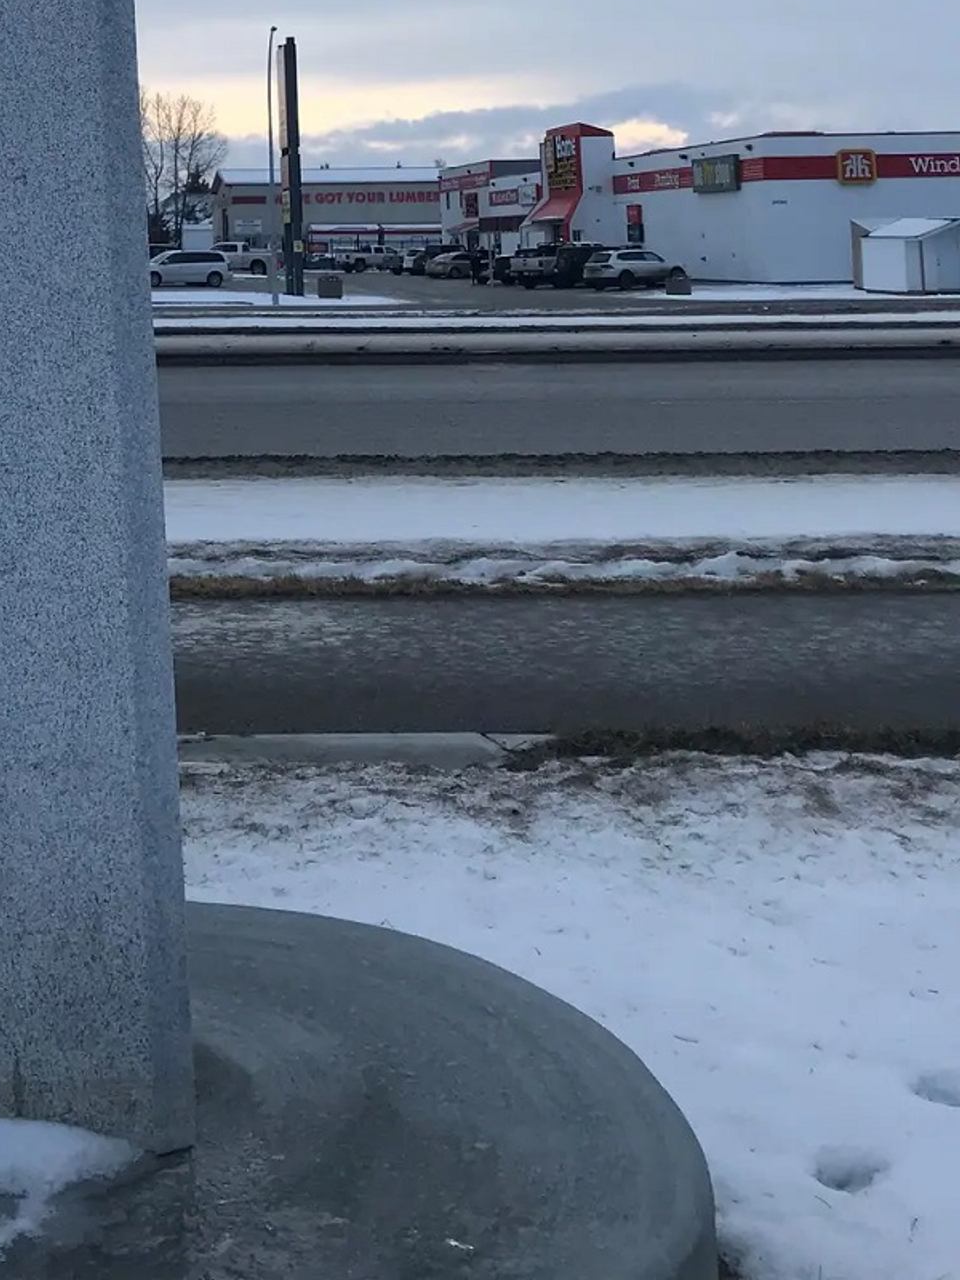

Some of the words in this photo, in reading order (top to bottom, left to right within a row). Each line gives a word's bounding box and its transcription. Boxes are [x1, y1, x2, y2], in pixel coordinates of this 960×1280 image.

[909, 156, 960, 173] Wind
[315, 192, 343, 205] GOT
[346, 191, 385, 204] YOUR
